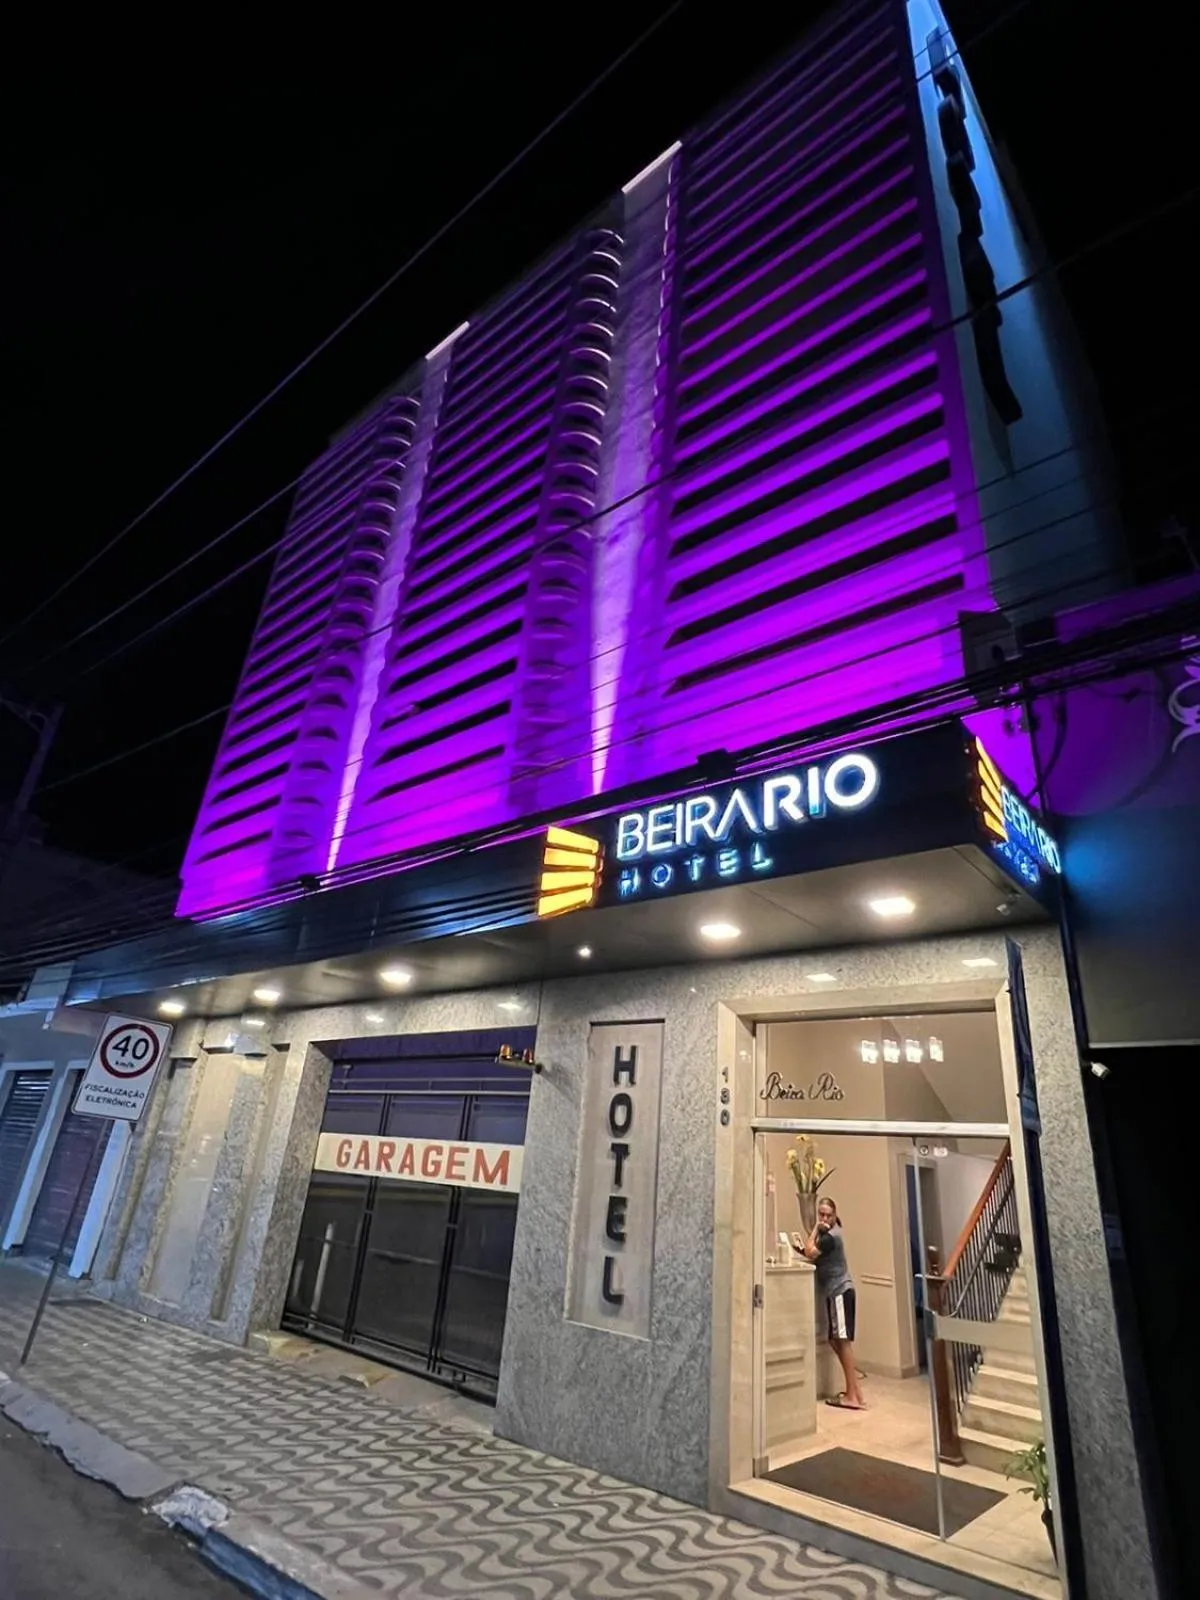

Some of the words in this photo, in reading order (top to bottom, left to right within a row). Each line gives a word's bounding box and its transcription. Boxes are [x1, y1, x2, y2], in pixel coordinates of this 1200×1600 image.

[618, 841, 775, 898] HOTEL
[112, 1035, 150, 1060] 40
[85, 1083, 145, 1099] FISCALIZAÇÃO
[760, 1071, 805, 1100] Beira
[808, 1072, 844, 1101] Rio
[335, 1139, 511, 1186] GARAGEM
[602, 1045, 637, 1304] HOTEL
